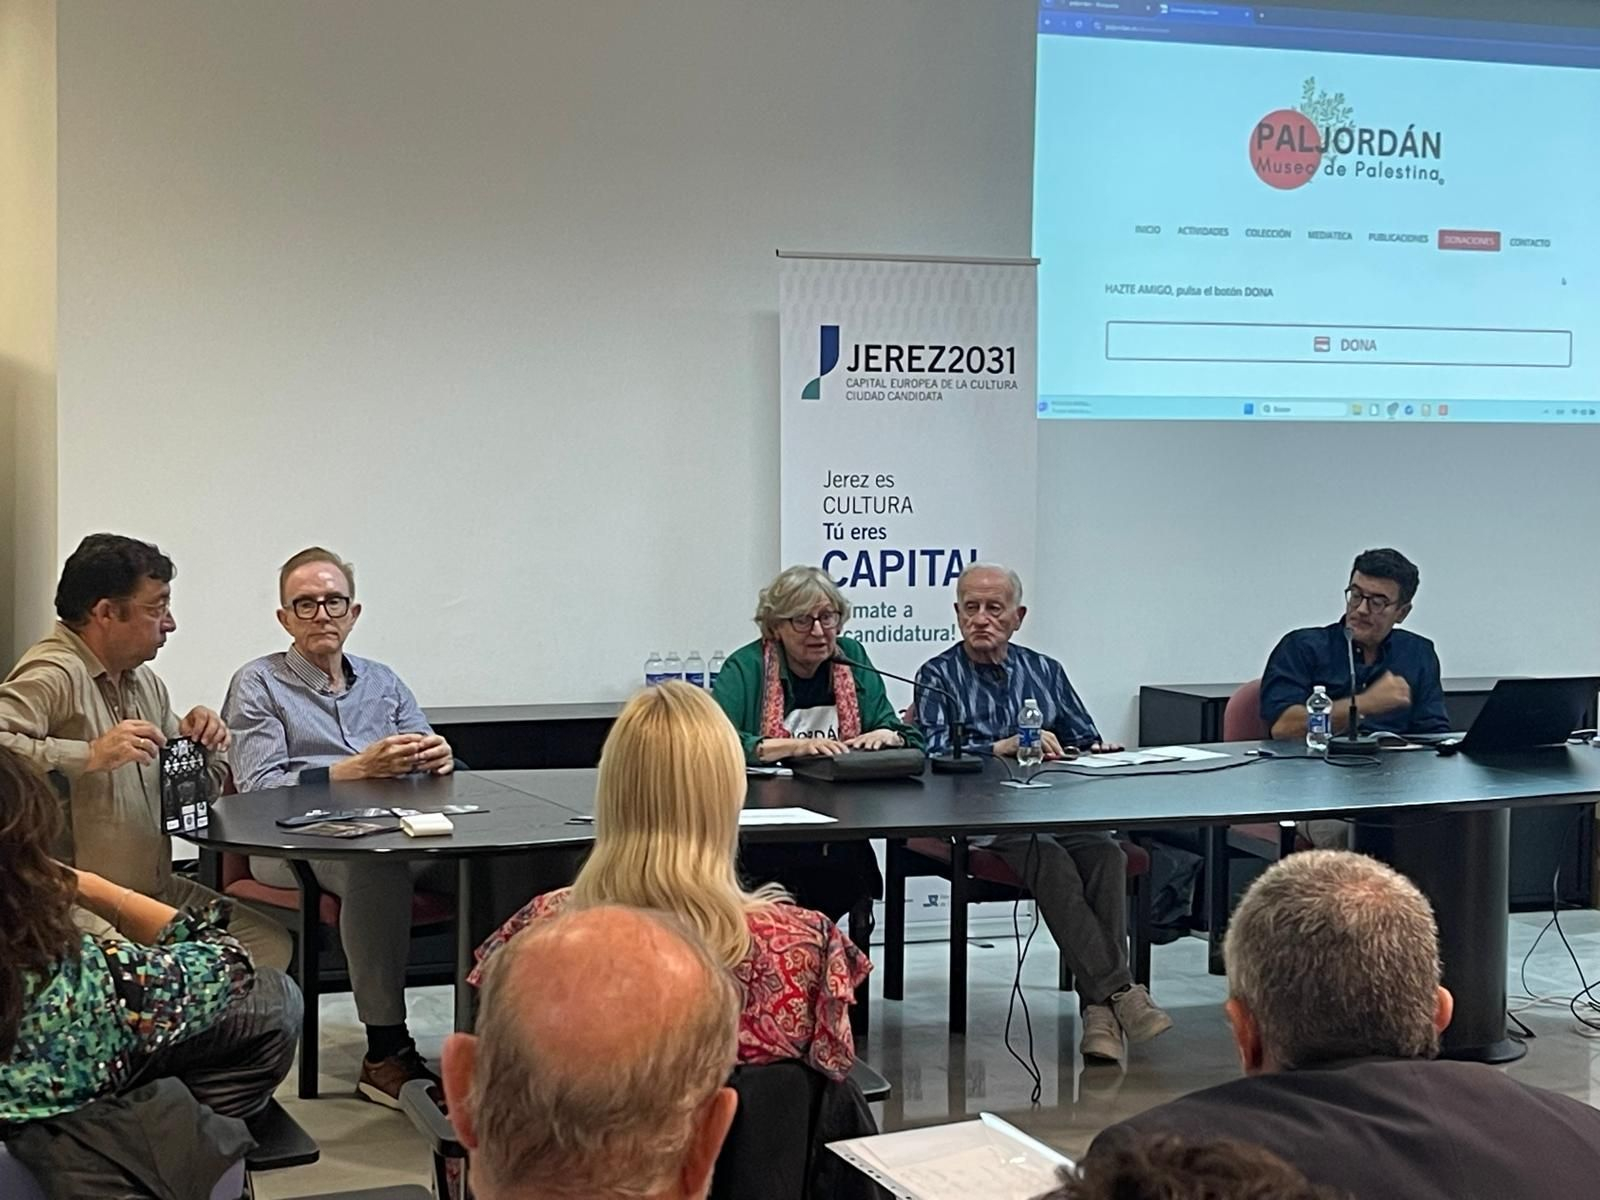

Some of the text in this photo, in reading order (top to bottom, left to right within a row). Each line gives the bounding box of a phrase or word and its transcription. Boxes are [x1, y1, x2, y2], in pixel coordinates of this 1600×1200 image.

[1256, 122, 1441, 159] PALJORDÁN
[1256, 157, 1316, 175] Museo
[1324, 160, 1347, 177] de
[1135, 225, 1551, 248] INICIO ACTIVIDADES COLECCIÓN MEDIATECA PUBLICACIONES DONACIONES CONTACTO
[1104, 283, 1274, 298] HAZTE AMIGO, pulsa el botón DONA
[1340, 338, 1377, 353] DONA
[846, 344, 1016, 375] JEREZ2031
[846, 378, 1018, 390] CAPITAL EUROPEA DE LA CULTURA
[846, 390, 943, 401] CIUDAD CANDIDATA
[823, 470, 895, 489] Jerez es
[823, 496, 914, 515] CULTURA
[823, 523, 887, 541] Tú eres
[903, 604, 913, 619] a
